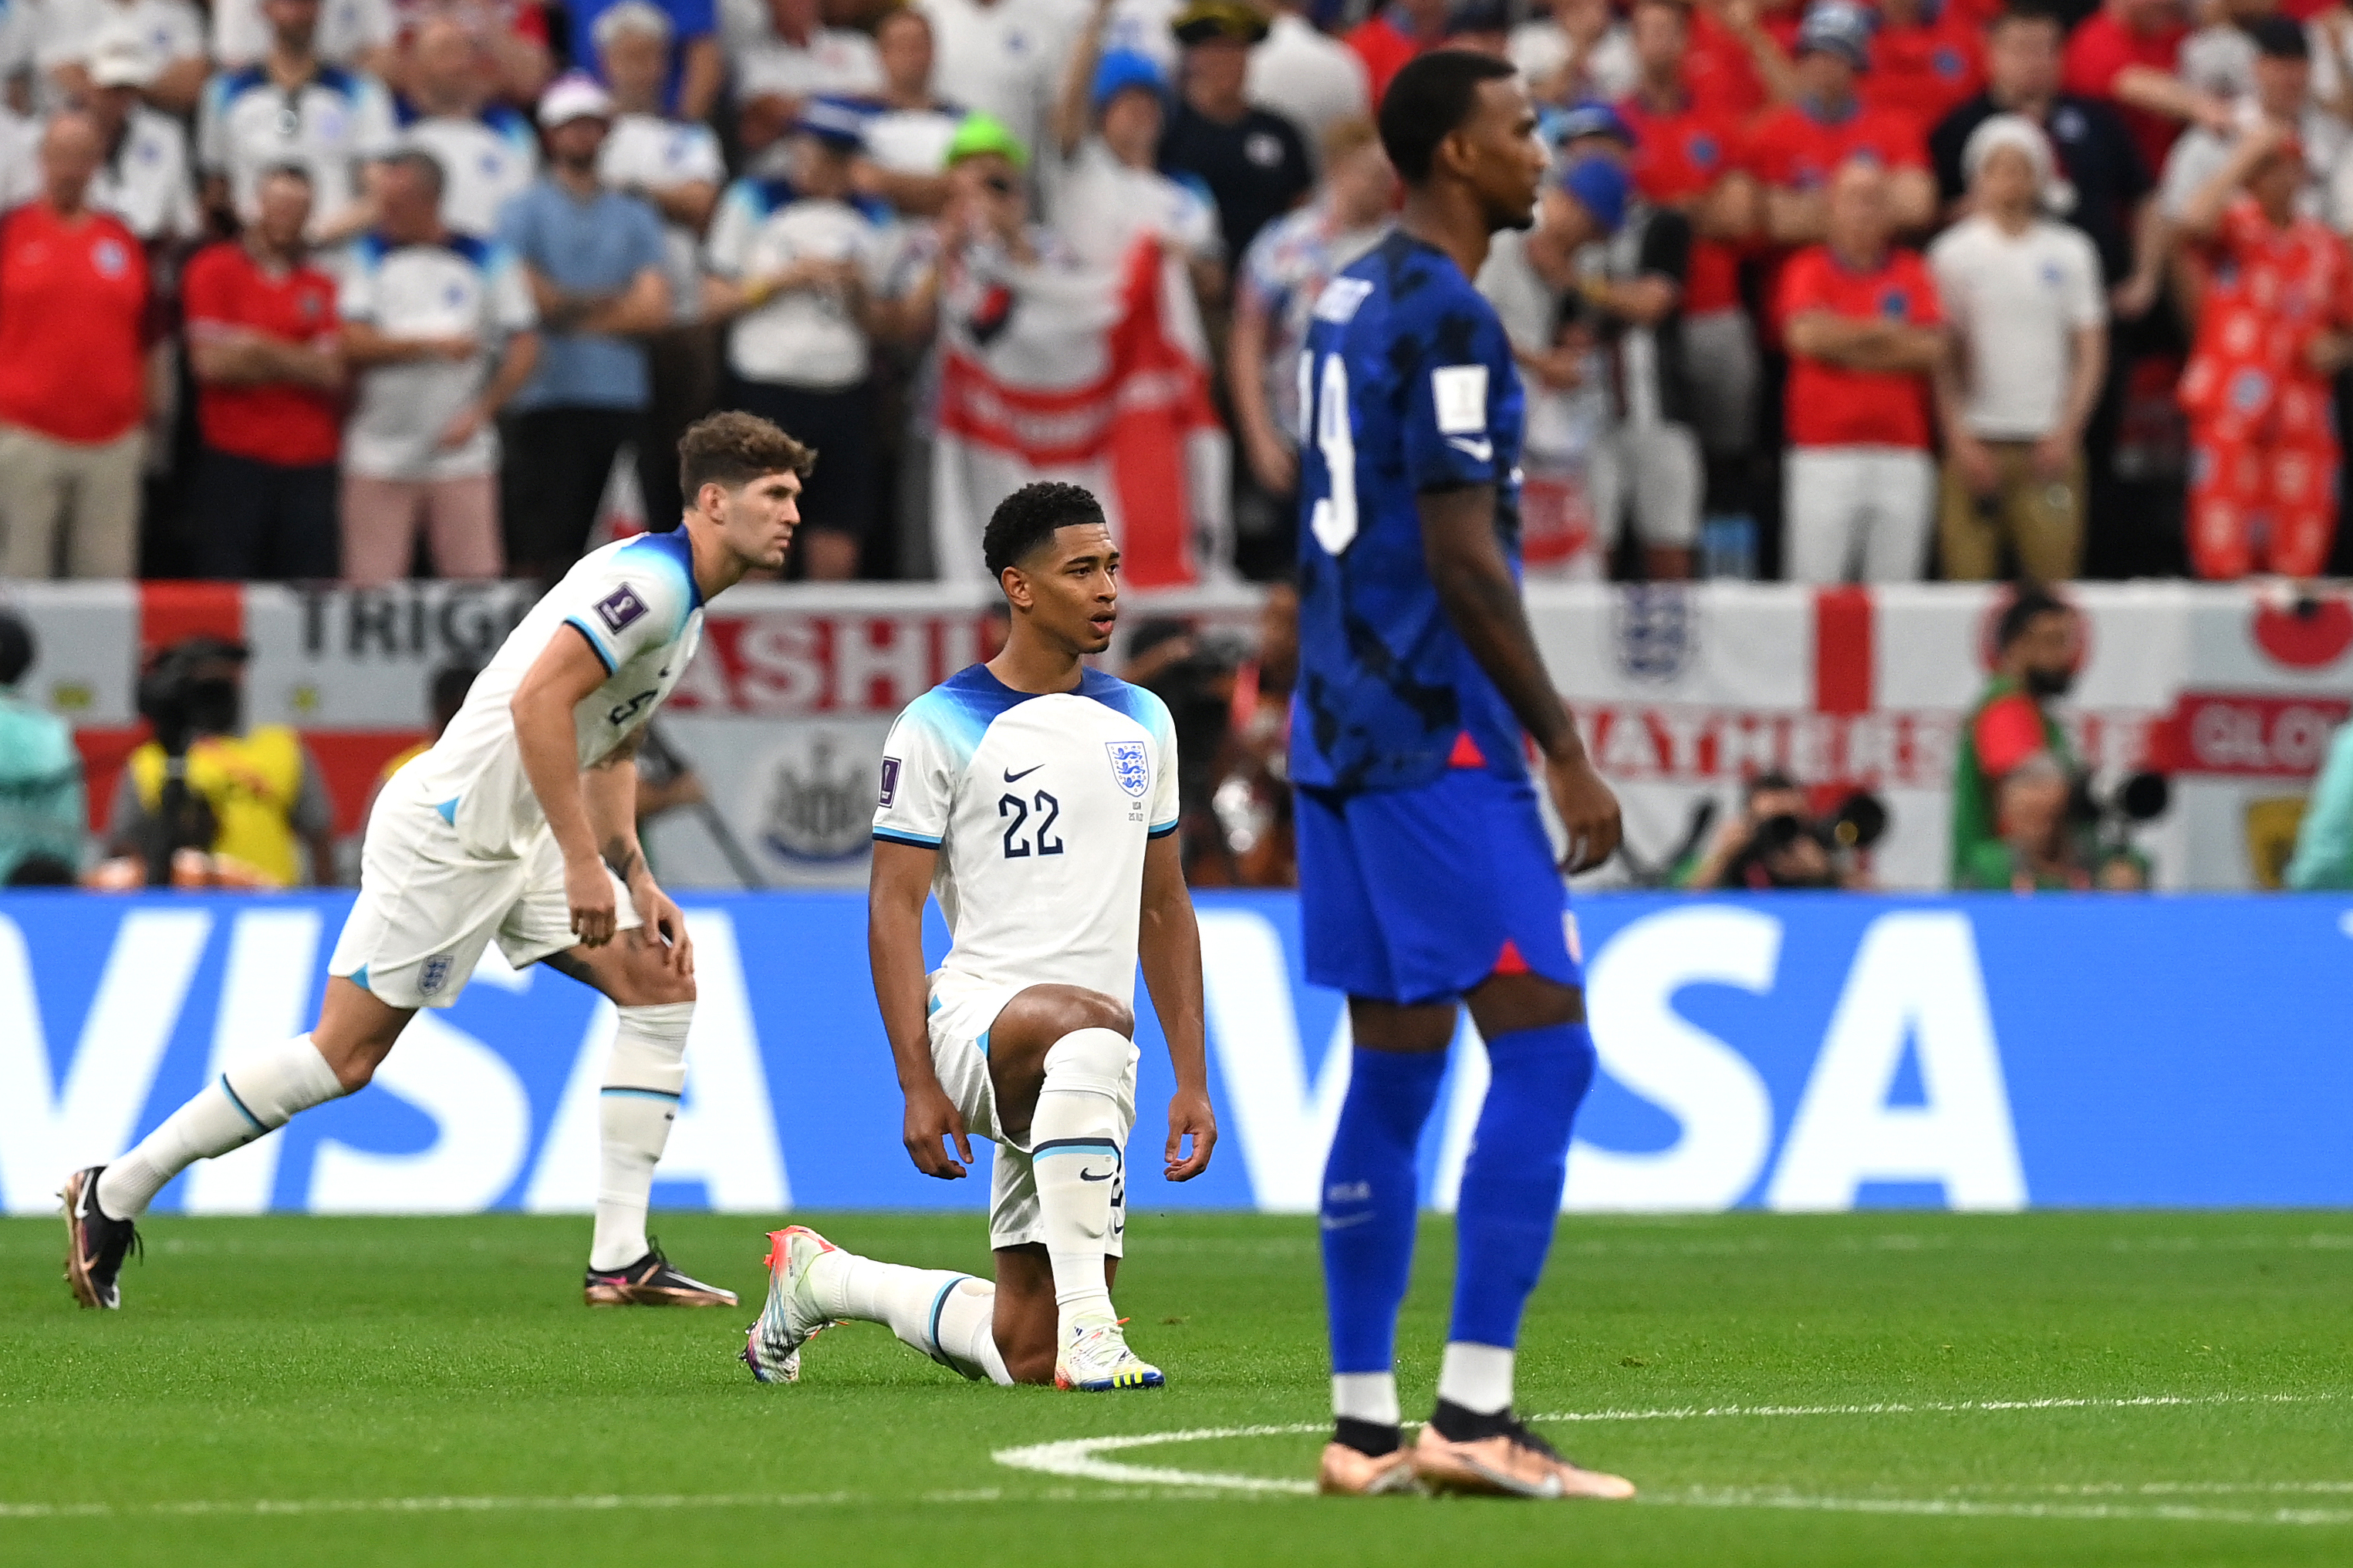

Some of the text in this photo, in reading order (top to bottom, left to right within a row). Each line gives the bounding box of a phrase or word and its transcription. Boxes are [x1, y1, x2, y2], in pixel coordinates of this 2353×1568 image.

[670, 620, 986, 705] ASHI
[609, 689, 659, 726] 5
[2191, 702, 2328, 768] GLO
[998, 789, 1064, 858] 22
[1193, 904, 2031, 1214] VSA
